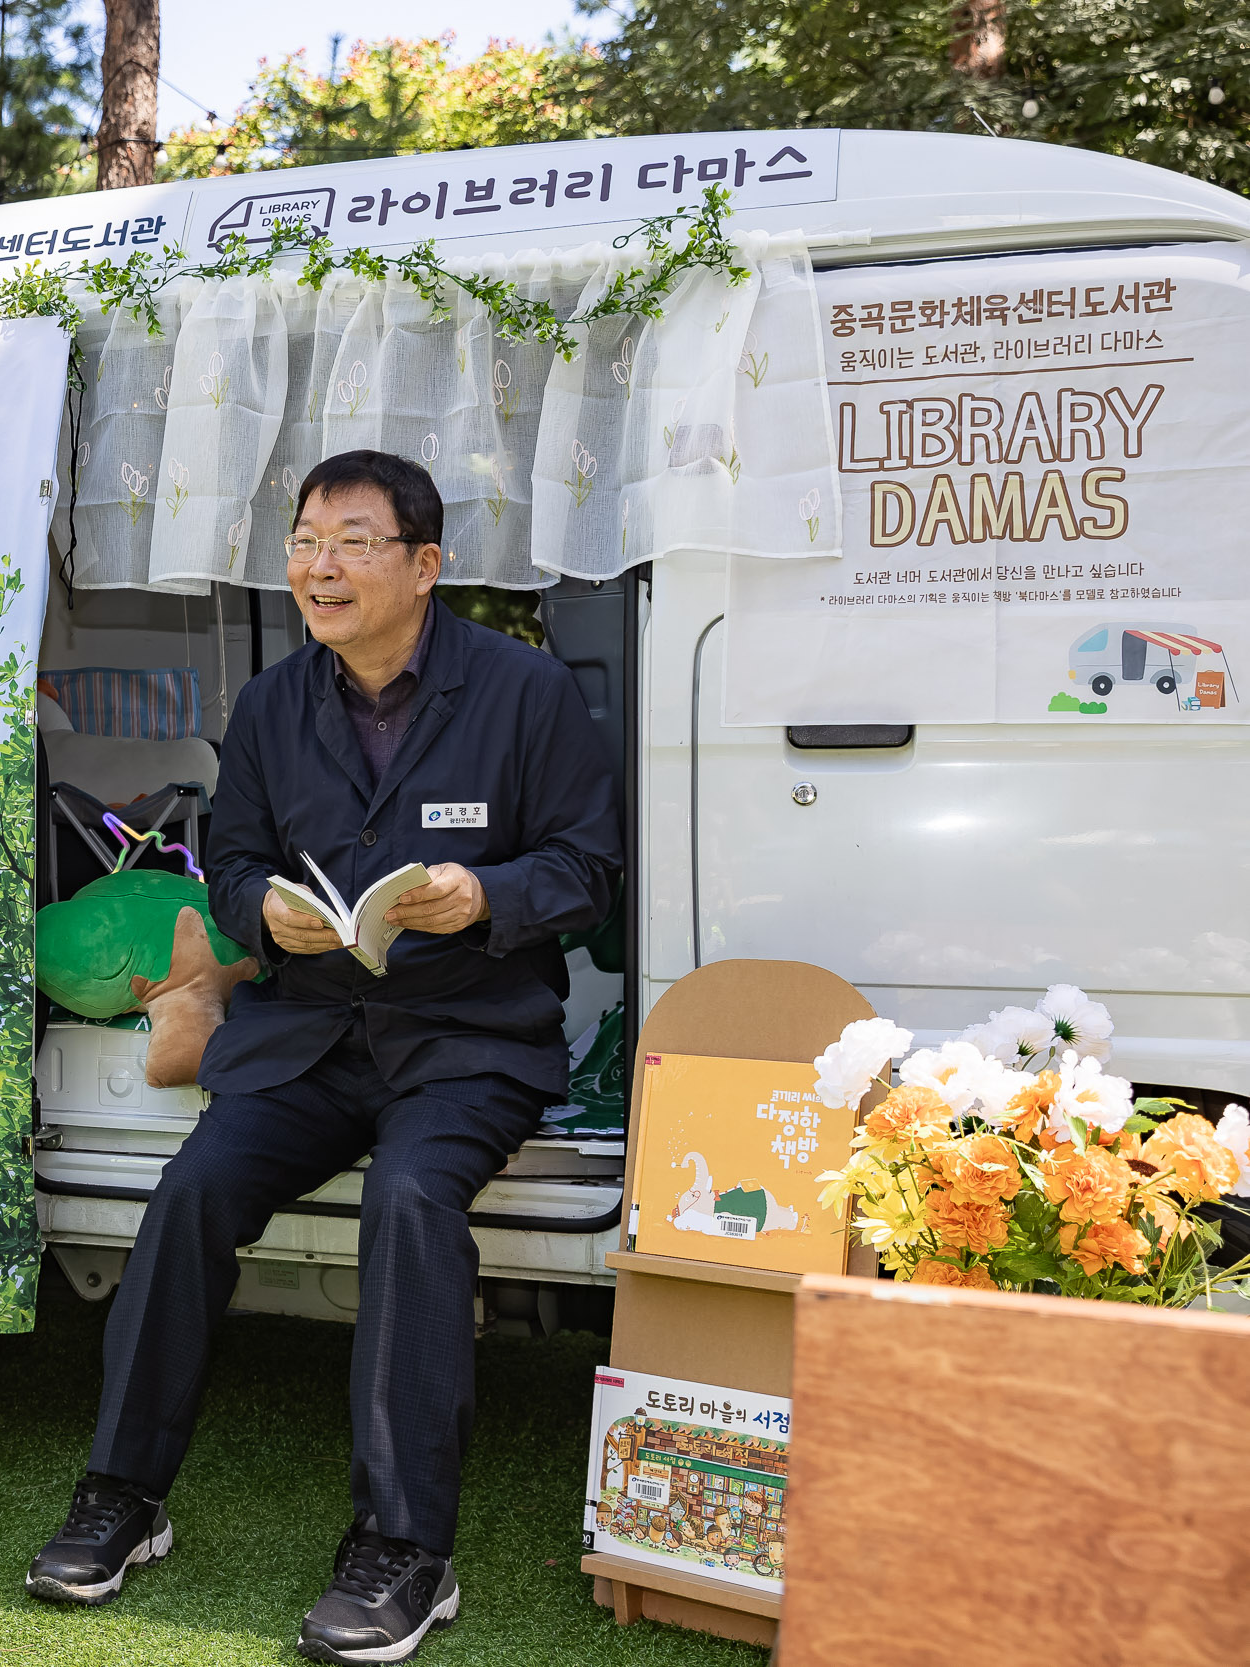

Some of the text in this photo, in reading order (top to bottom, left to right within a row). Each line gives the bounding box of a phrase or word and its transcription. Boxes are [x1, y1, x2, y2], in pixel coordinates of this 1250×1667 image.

[348, 146, 813, 226] 라이브러리 다마스
[259, 200, 320, 214] LIBRARY
[830, 278, 1177, 338] 중곡문화체육센터도서관
[840, 329, 1164, 373] 움직이는 도서관, 라이브러리 다마스
[838, 383, 1165, 474] LIBRARY
[869, 466, 1129, 549] DAMAS
[853, 562, 1145, 585] 도서관 너머 도서관에서 당신을 만나고 싶습니다
[828, 595, 875, 606] 라이브러리
[877, 594, 917, 605] 다마스의
[919, 593, 948, 604] 기획은
[951, 592, 990, 603] 움직이는
[993, 590, 1012, 603] 책방
[1075, 588, 1106, 601] 모델로
[1109, 587, 1182, 599] 참고하였습니다
[770, 1090, 801, 1103] 코끼리
[756, 1103, 821, 1137] 다정한
[771, 1135, 819, 1169] 책방
[646, 1390, 695, 1416] 도토리
[753, 1410, 791, 1434] 서점
